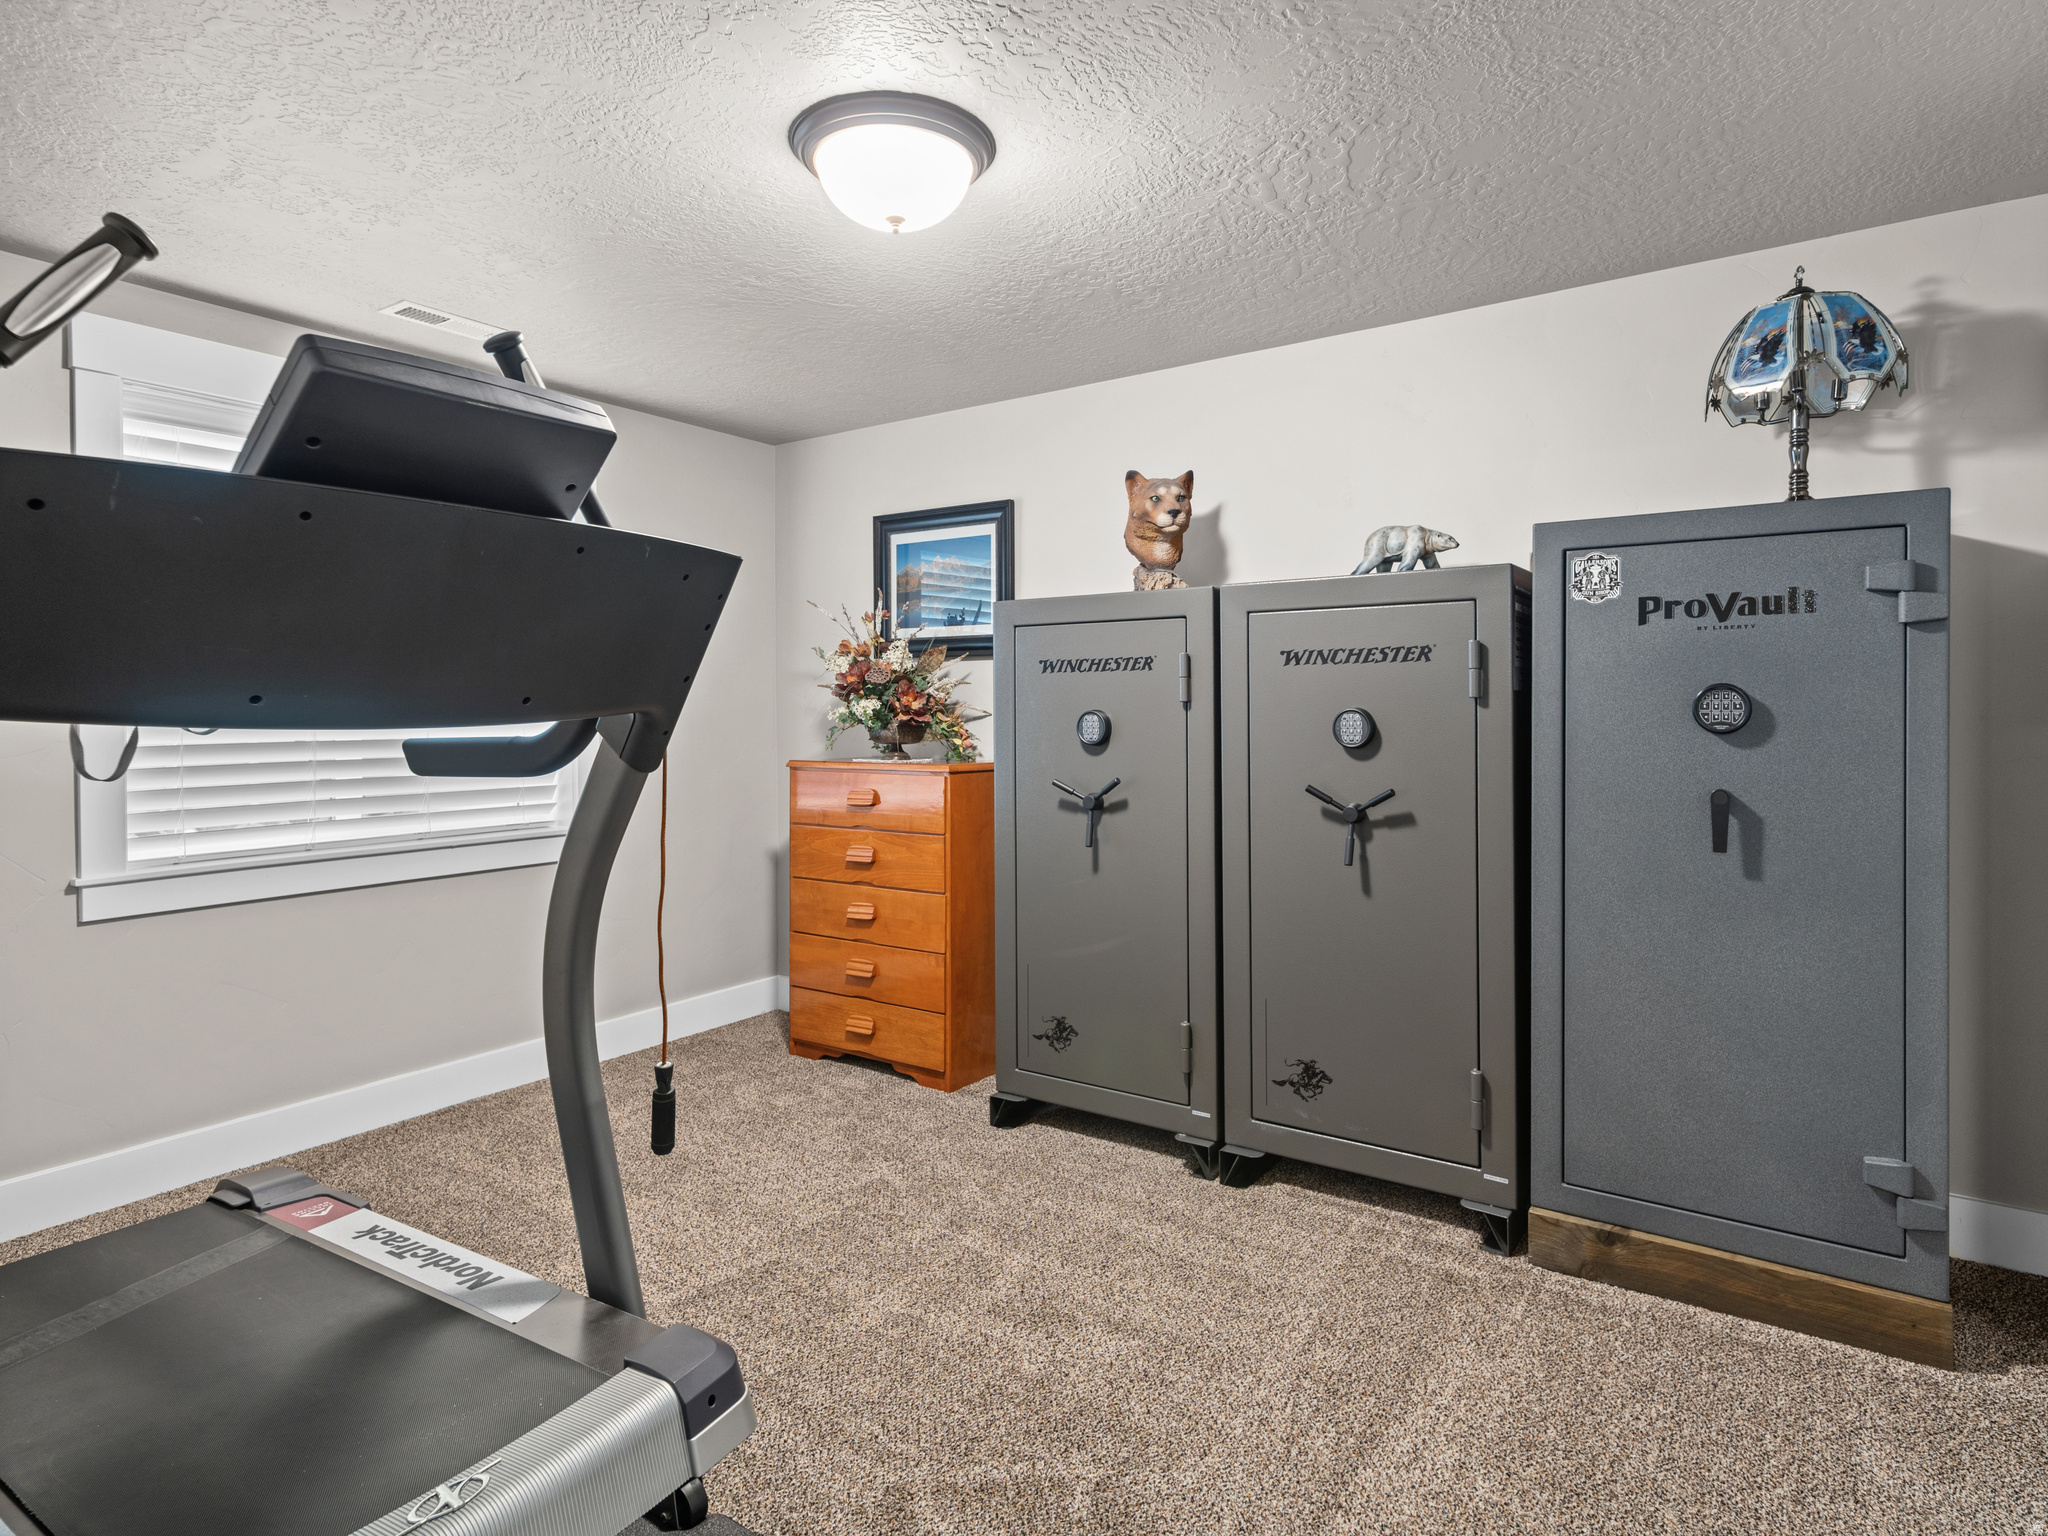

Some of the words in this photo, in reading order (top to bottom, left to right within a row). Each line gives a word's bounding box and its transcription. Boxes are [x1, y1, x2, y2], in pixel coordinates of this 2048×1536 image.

[1638, 586, 1818, 627] ProVault
[1039, 656, 1154, 674] WINCHESTER
[1280, 644, 1433, 667] WINCHESTER
[351, 1224, 505, 1291] NordicTrack
